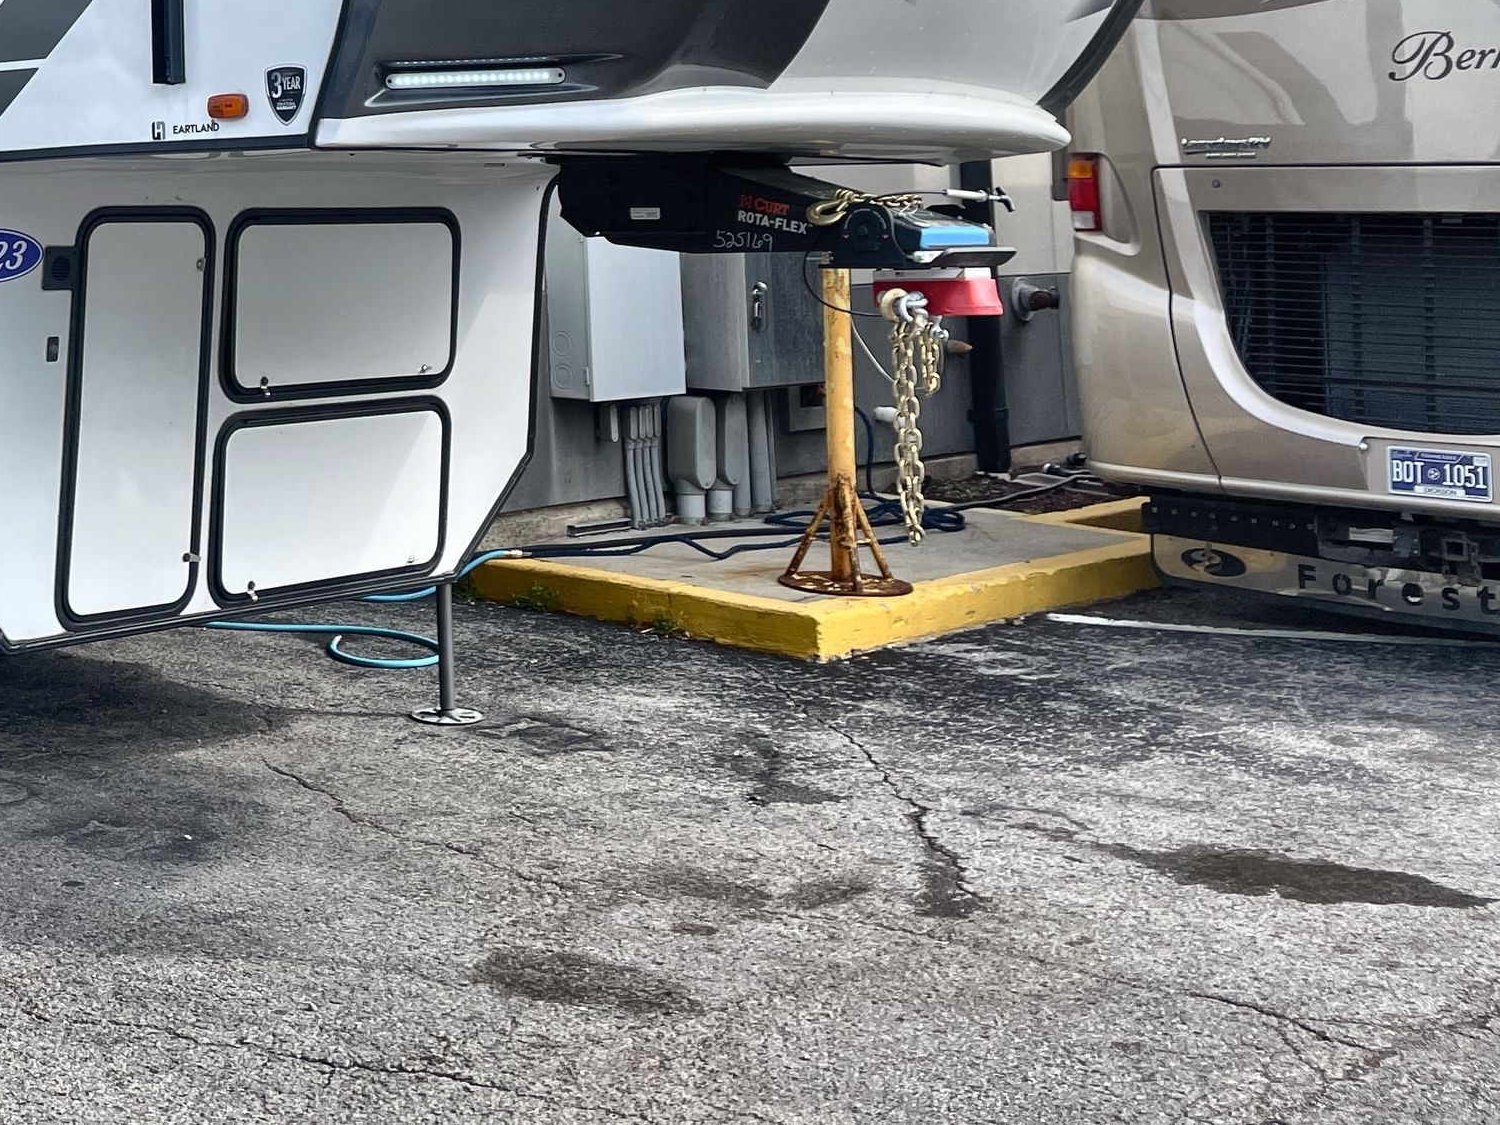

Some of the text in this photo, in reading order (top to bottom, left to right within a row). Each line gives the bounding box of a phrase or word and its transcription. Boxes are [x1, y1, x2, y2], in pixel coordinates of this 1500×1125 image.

[270, 71, 301, 98] 3 YEAR
[755, 198, 790, 215] CURT
[737, 210, 808, 234] ROTA-FLEX
[713, 230, 773, 252] 525169
[1442, 463, 1488, 489] 1051
[1298, 563, 1500, 615] Forest
